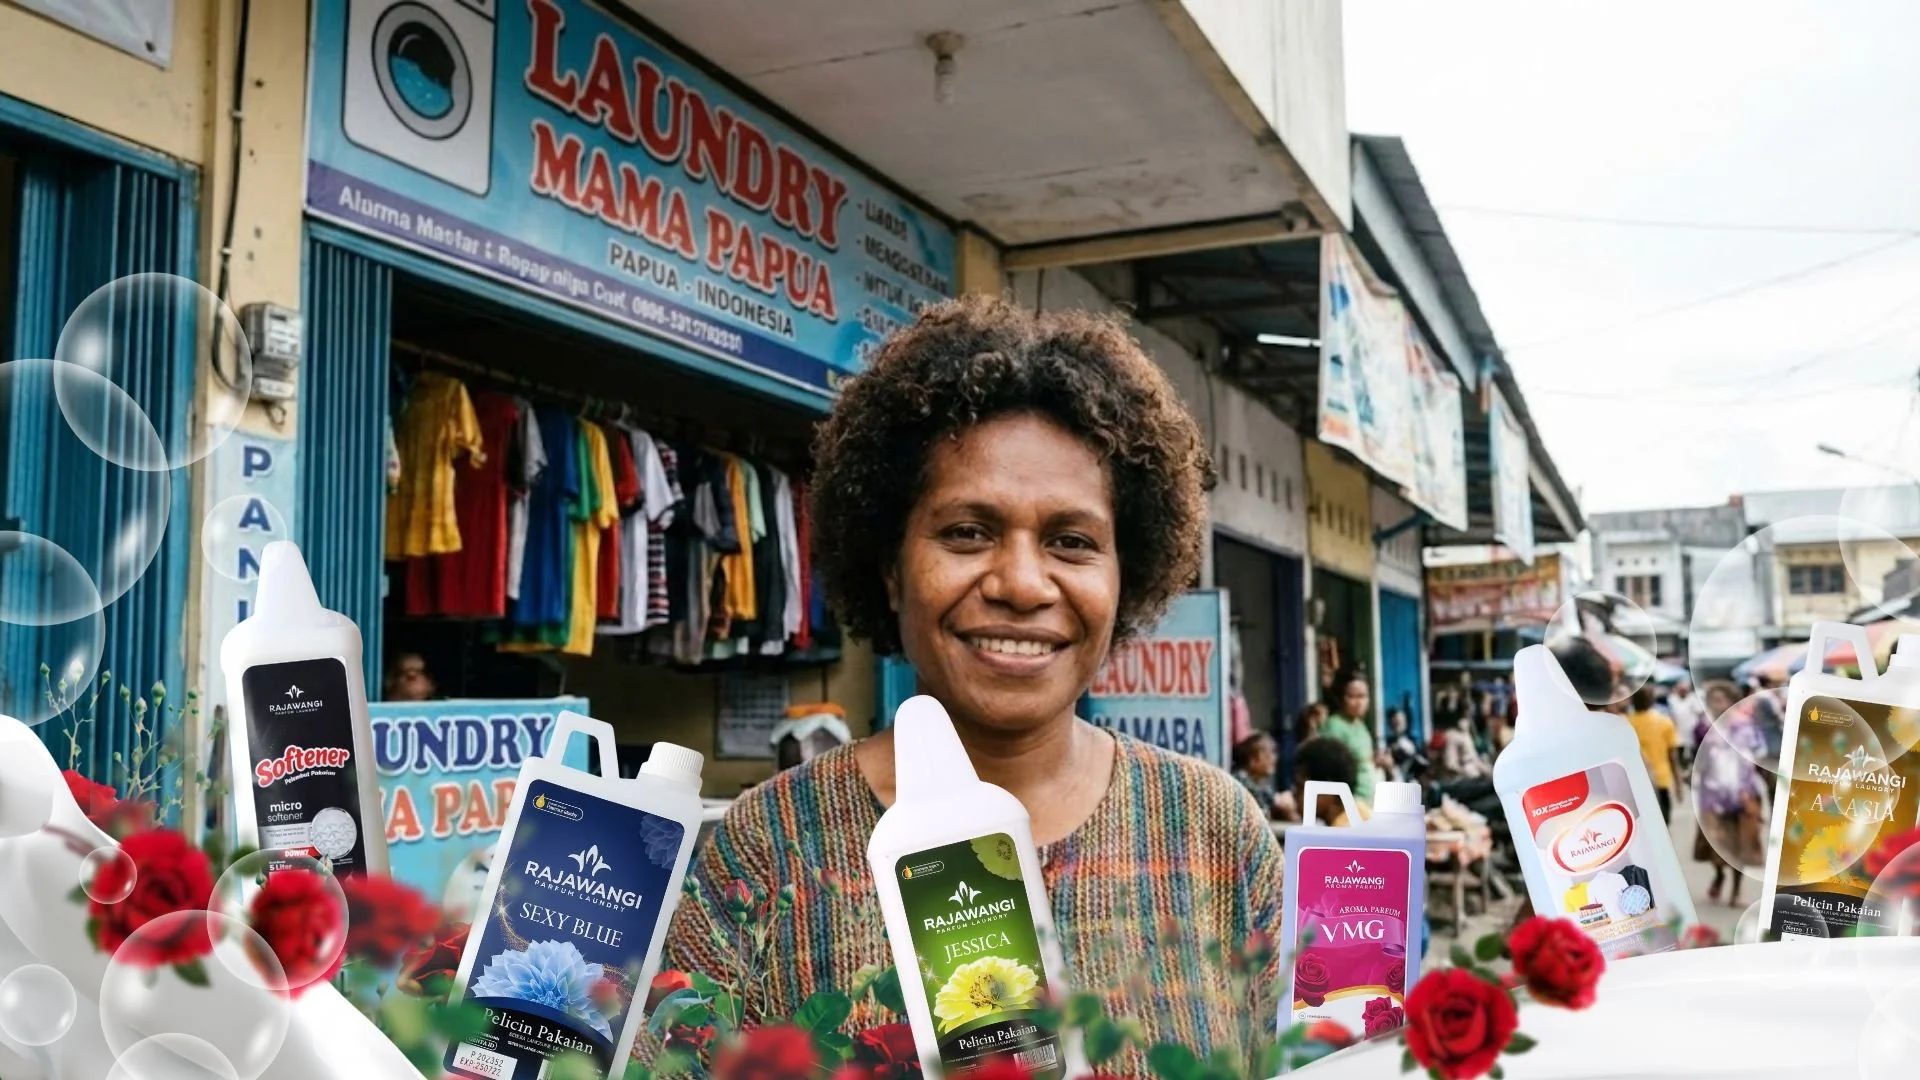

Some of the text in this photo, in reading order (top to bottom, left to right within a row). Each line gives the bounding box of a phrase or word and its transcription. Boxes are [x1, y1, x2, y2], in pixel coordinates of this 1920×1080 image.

[525, 0, 847, 249] LAUNDRY
[531, 119, 698, 261] MAMA
[705, 205, 838, 321] PAPUA
[609, 241, 680, 292] PAPUA
[696, 279, 794, 338] INDONESIA
[269, 700, 323, 713] RAJAWANGI
[255, 744, 350, 788] Softener
[1808, 763, 1907, 789] RAJAWANGI
[1855, 783, 1895, 794] LAUNDRY
[267, 811, 304, 823] softener
[270, 801, 302, 813] micro
[1531, 805, 1549, 817] 10X
[1809, 793, 1895, 822] AASIA
[1570, 837, 1618, 858] RAJAWANGI
[524, 860, 643, 910] RAJAWANGI
[1324, 876, 1386, 886] RAJAWANGI
[534, 879, 627, 913] PARFUM LAUNDRY
[1793, 895, 1834, 911] Pelicin
[1837, 901, 1882, 918] Pakaian
[923, 898, 1016, 931] RAJAWANGI
[1339, 905, 1368, 914] AROMA
[519, 901, 624, 948] SEXY BLUE
[936, 913, 1009, 935] PARFUM LAUNDRY
[944, 931, 1012, 964] JESSICA
[483, 1007, 535, 1036] Pelicin
[536, 1025, 595, 1056] Pakaian
[958, 1033, 996, 1050] Pelicin
[997, 1025, 1038, 1042] Pakaian
